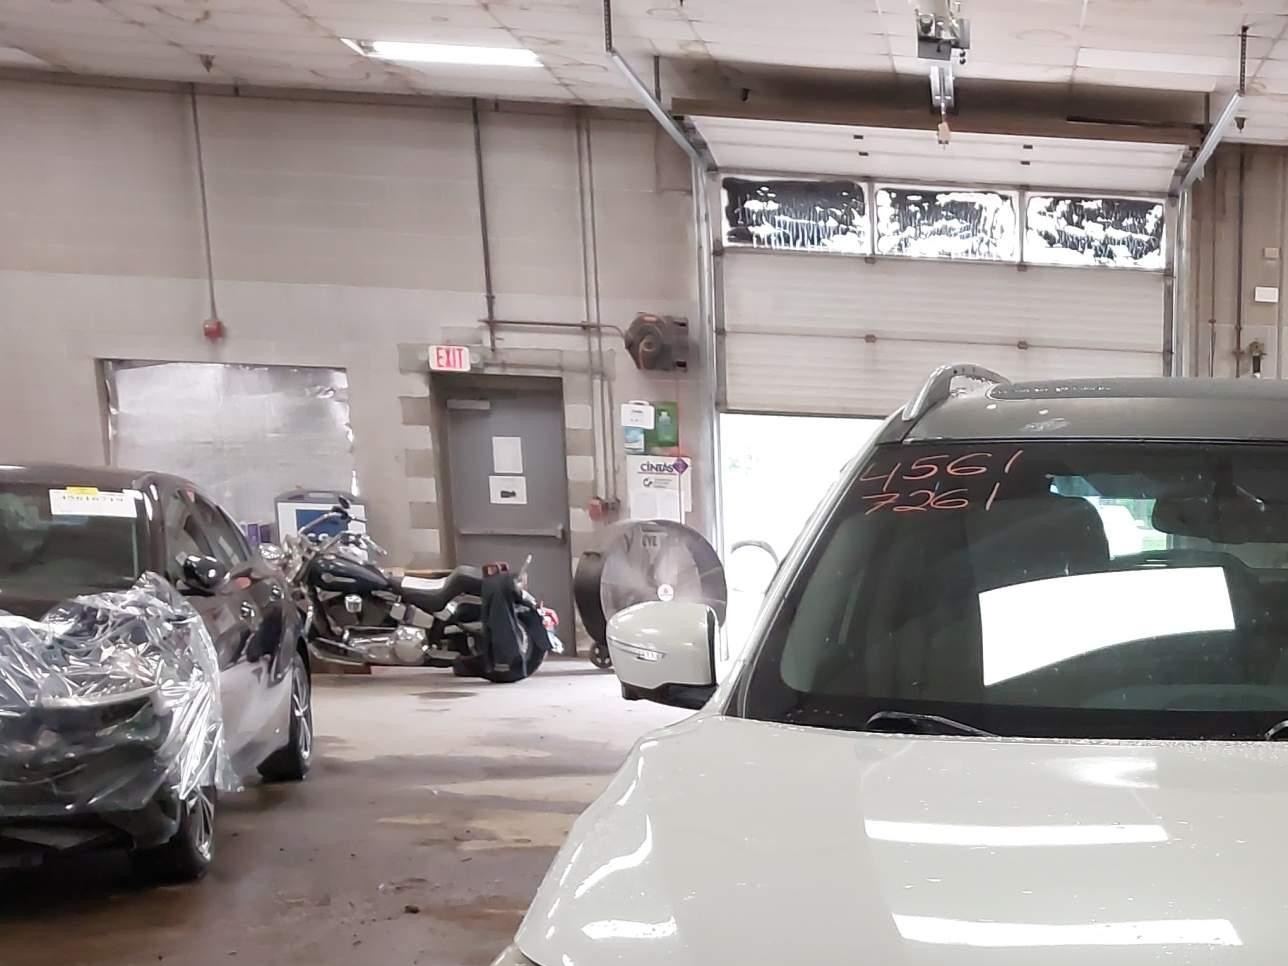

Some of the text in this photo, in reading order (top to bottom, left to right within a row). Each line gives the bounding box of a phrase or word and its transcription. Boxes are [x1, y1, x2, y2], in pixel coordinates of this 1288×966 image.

[436, 347, 464, 368] EXIT
[859, 450, 1024, 492] 4561
[861, 482, 1001, 515] 7261
